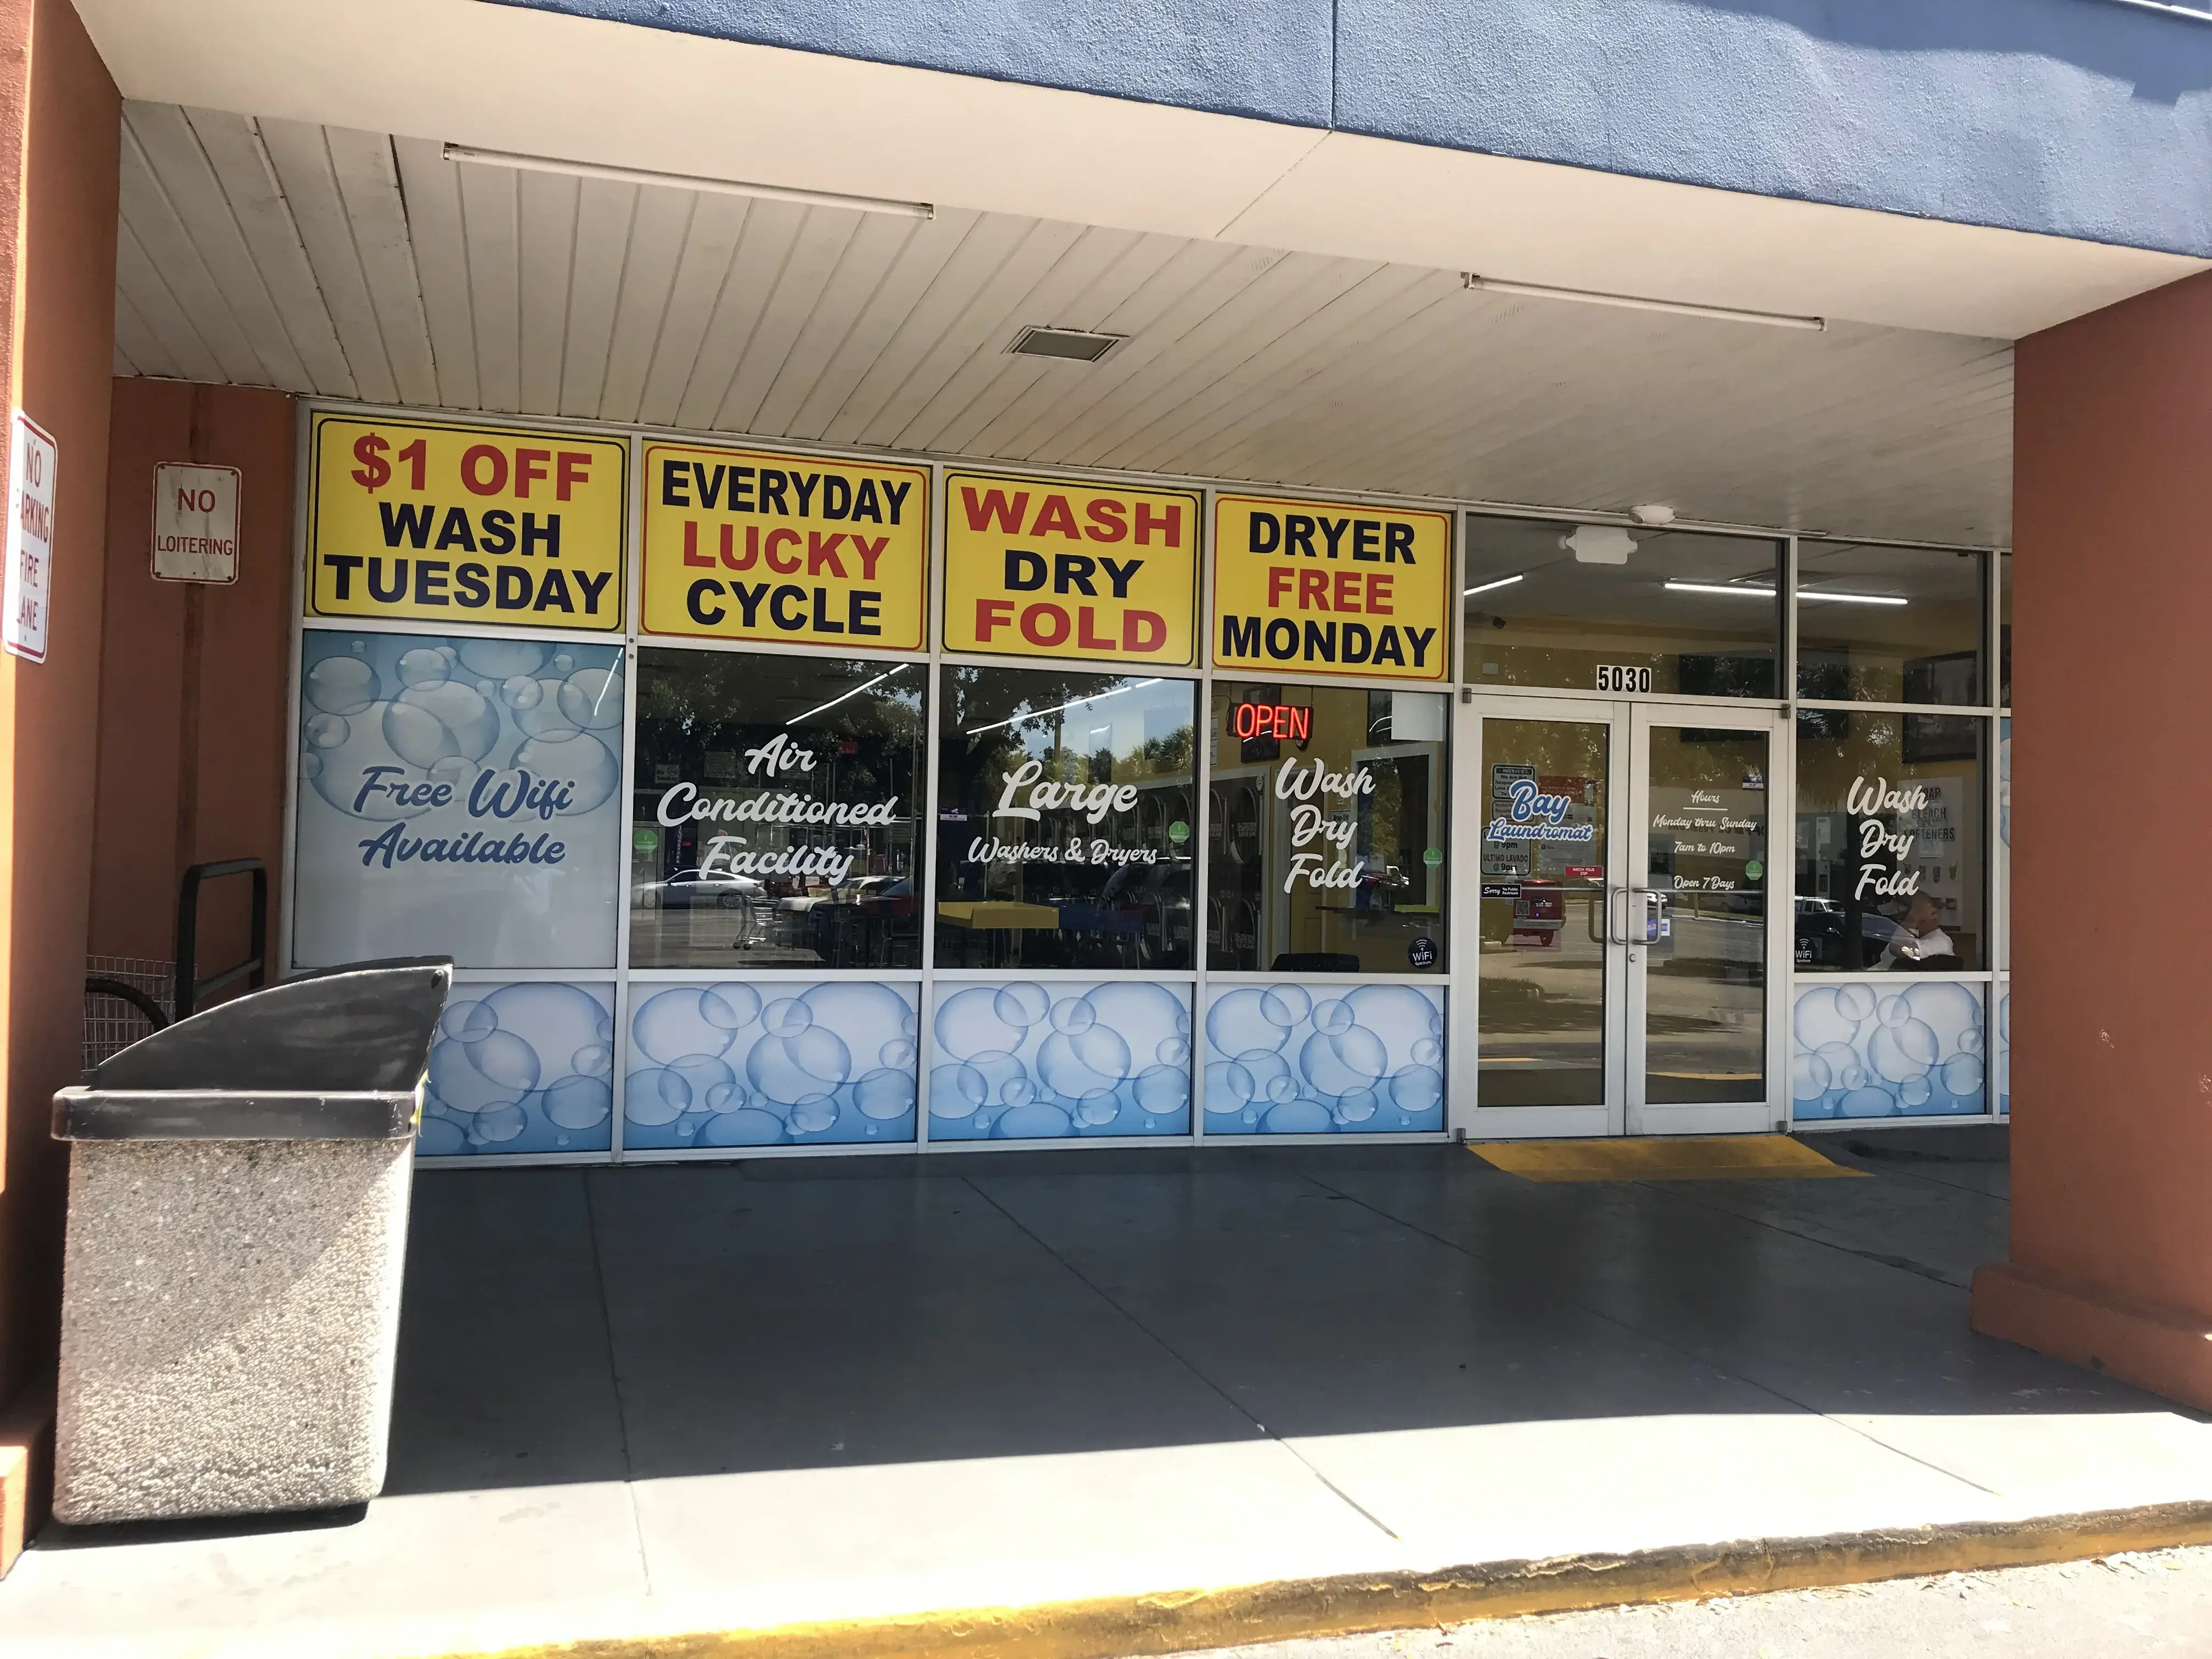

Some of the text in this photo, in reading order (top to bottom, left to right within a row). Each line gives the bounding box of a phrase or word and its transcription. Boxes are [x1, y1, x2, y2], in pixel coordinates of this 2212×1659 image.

[26, 442, 42, 488] NO
[351, 432, 592, 501] $1 OFF
[177, 488, 216, 514] NO
[662, 459, 912, 526] EVERYDAY
[18, 487, 49, 544] ARKING
[379, 501, 561, 558] WASH
[960, 486, 1181, 548] WASH
[157, 535, 234, 556] LOITERING
[683, 520, 890, 580] LUCKY
[1249, 511, 1417, 565] DRYER
[20, 549, 40, 588] FIRE
[324, 554, 613, 614] TUESDAY
[1005, 549, 1145, 599] DRY
[1268, 566, 1394, 615] FREE
[686, 578, 882, 636] CYCLE
[975, 599, 1167, 652] FOLD
[1222, 615, 1437, 667] MONDAY
[1598, 666, 1650, 693] 5030
[1235, 703, 1309, 740] OPEN
[744, 733, 817, 777] Air
[353, 766, 575, 821] Free Wifi
[992, 760, 1138, 824] Large
[1275, 757, 1376, 800] Wash
[1691, 790, 1720, 804] Hours
[1847, 776, 1929, 816] Wash
[657, 782, 899, 827] Conditioned
[1510, 779, 1571, 825] Bay
[1653, 814, 1692, 829] Monday
[1694, 817, 1717, 827] thru
[1719, 817, 1757, 831] Sunday
[358, 822, 566, 869] Available
[1290, 804, 1358, 850] Dry
[1487, 817, 1593, 842] Laundromat
[1674, 841, 1736, 854] 7am to 10pm
[1859, 819, 1915, 861] Dry
[698, 836, 855, 886] Facility
[968, 837, 1158, 867] Washers & Dryers
[1284, 853, 1365, 894] Fold
[1483, 853, 1505, 862] ULTIMO
[1483, 887, 1501, 895] Sorry
[1674, 875, 1735, 890] Open 7 Days
[1854, 863, 1921, 901] Fold
[1412, 950, 1432, 961] WiFi
[1795, 950, 1812, 958] WiFi
